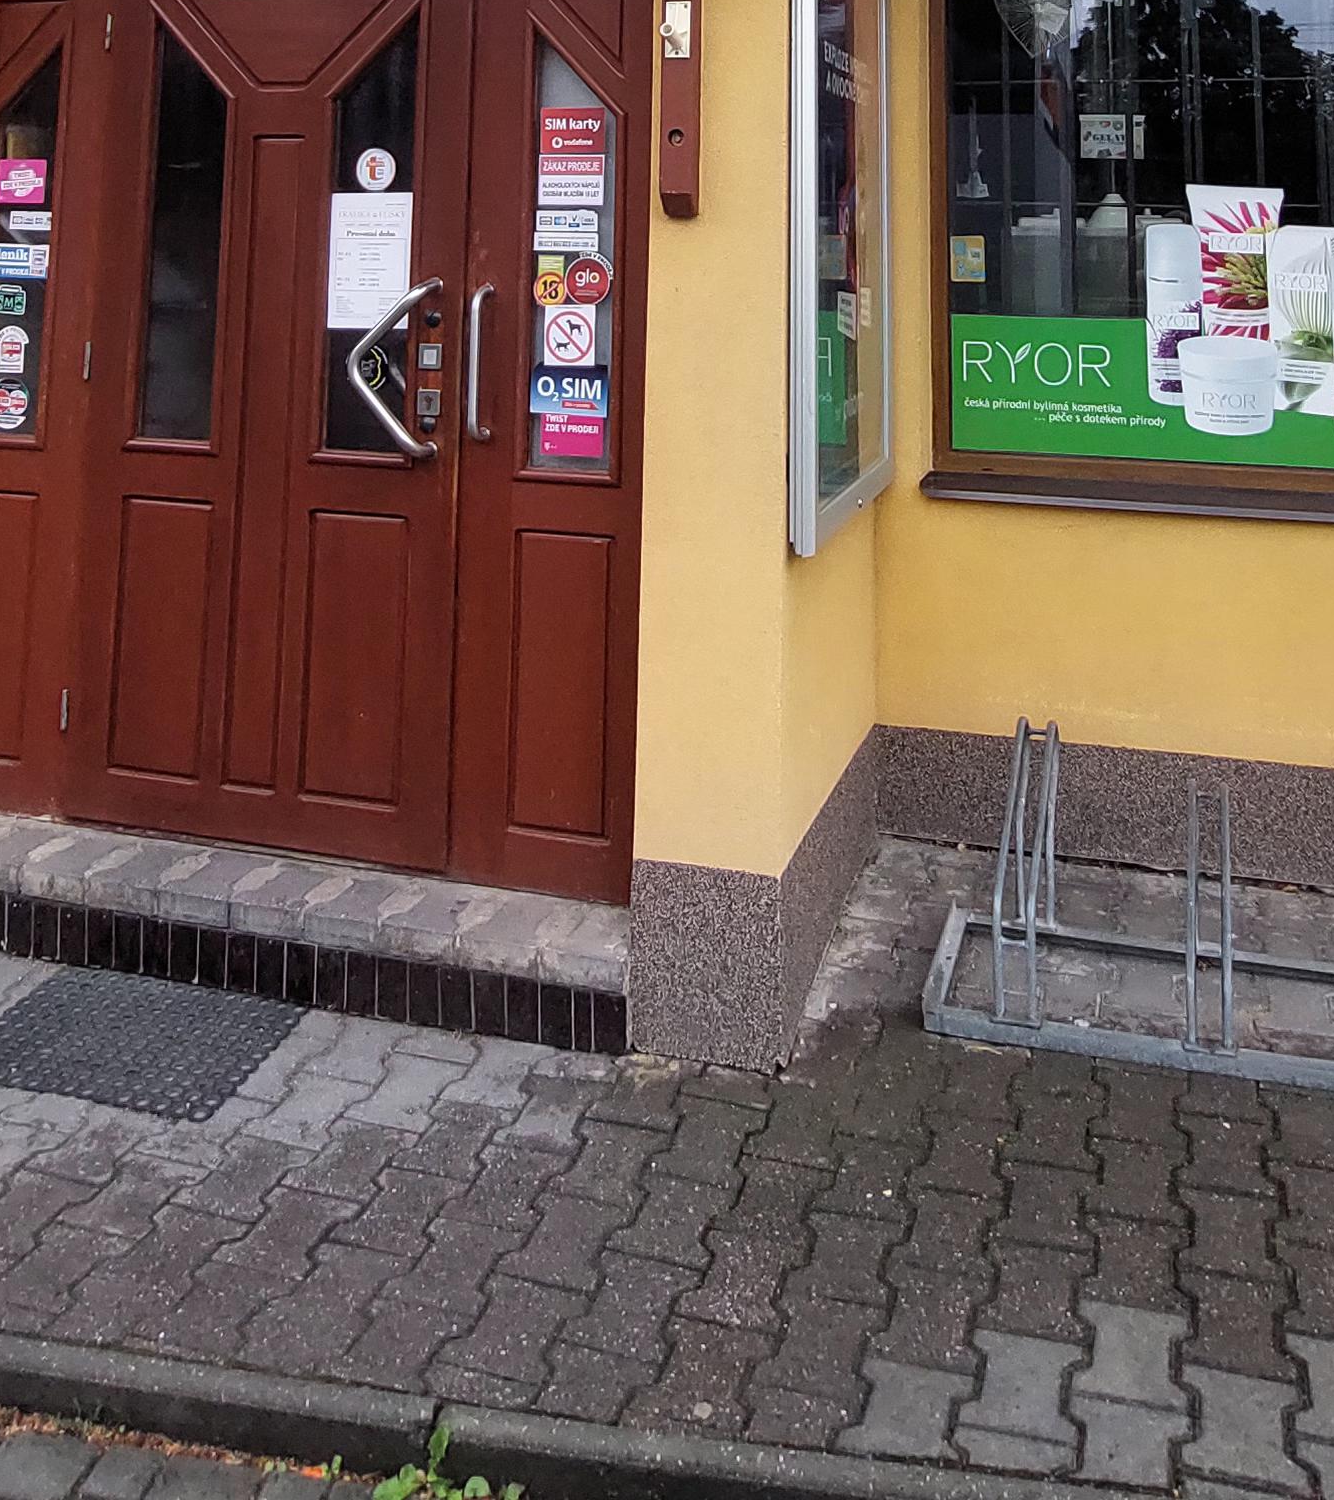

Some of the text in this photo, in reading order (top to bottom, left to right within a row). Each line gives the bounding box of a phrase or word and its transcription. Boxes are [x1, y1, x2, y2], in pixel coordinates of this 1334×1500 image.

[544, 117, 601, 133] SIM karty
[563, 138, 594, 146] vodafone
[543, 160, 601, 172] ZÁKAZ PRODEJE
[1211, 235, 1262, 251] RYOR
[575, 267, 600, 286] glo
[1274, 273, 1326, 290] RYOR
[541, 280, 559, 300] 18
[1153, 314, 1197, 329] RYOR
[963, 341, 1111, 387] RYOR
[561, 377, 601, 400] SIM
[964, 397, 1122, 414] česká přírodní bylinná kosmetika
[1202, 392, 1257, 410] RYOR
[1048, 412, 1073, 423] péče
[1075, 415, 1081, 423] s
[1082, 414, 1127, 425] dotekem
[1130, 415, 1166, 428] přírody
[545, 423, 599, 434] ZDE V PRODEJI
